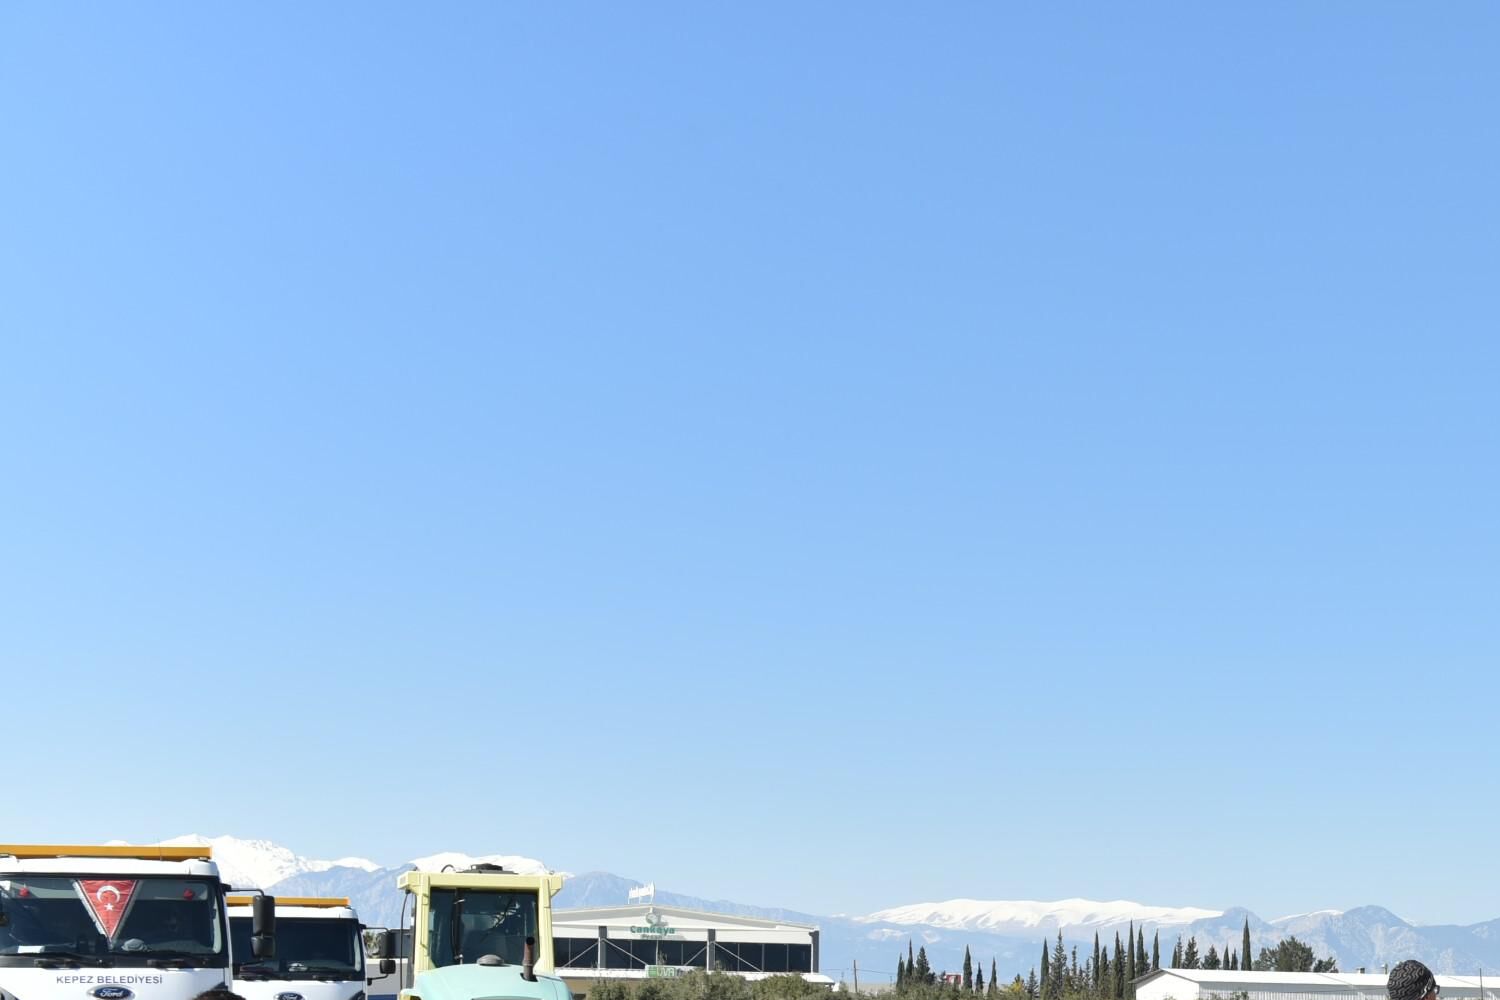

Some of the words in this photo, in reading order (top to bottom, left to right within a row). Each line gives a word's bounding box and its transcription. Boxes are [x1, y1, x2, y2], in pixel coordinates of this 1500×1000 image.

[57, 976, 93, 984] KEPEZ
[97, 974, 163, 984] BELEDİYESİ
[100, 988, 124, 998] Ford
